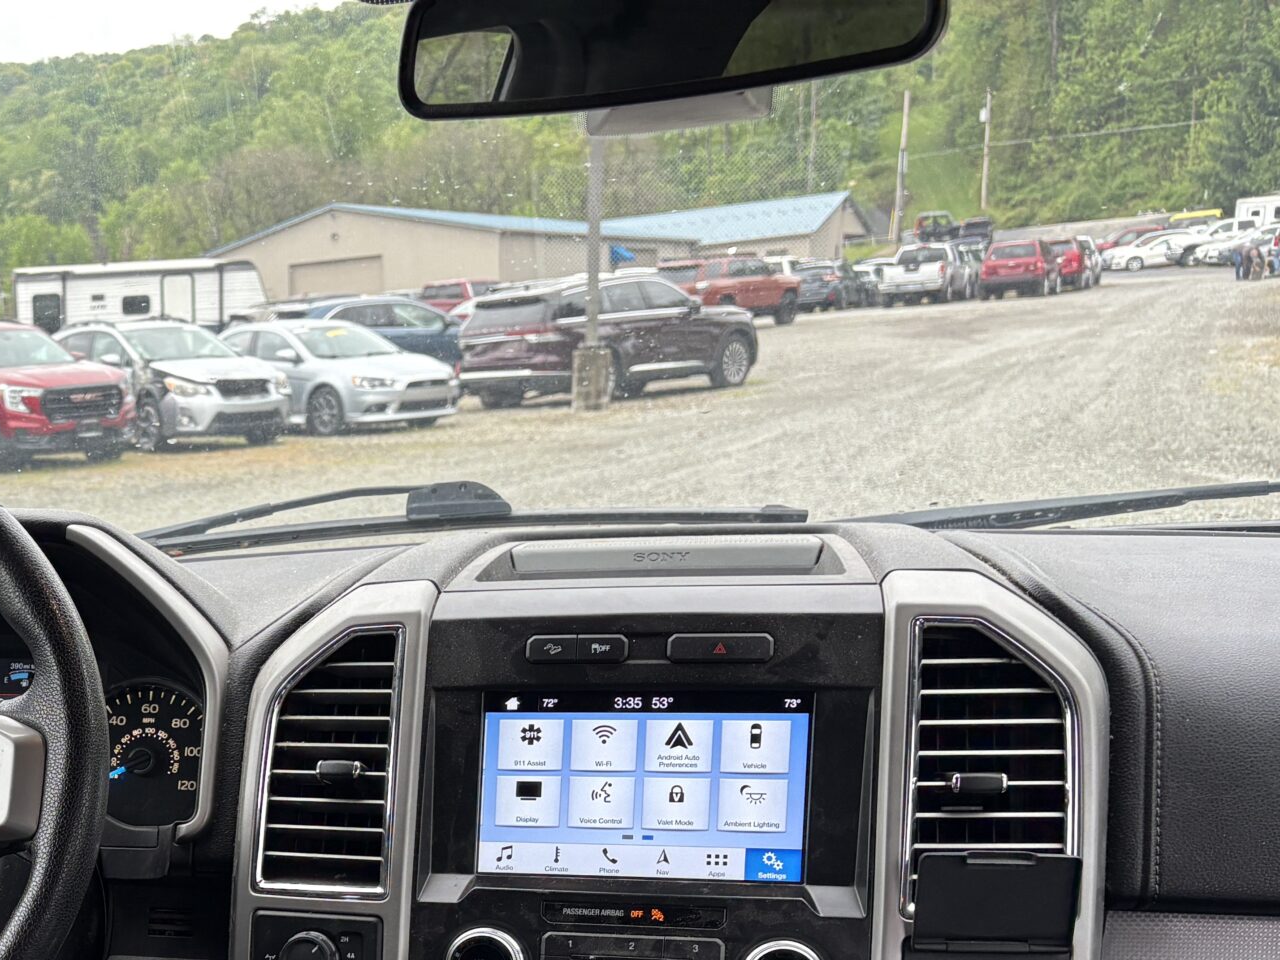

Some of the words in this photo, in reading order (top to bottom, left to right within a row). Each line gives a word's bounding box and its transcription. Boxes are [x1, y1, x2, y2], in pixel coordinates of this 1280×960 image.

[632, 551, 690, 563] SONY
[599, 643, 611, 652] OFF
[614, 697, 642, 709] 3:35
[141, 704, 159, 714] 60
[109, 716, 126, 725] 40
[171, 718, 190, 728] 80
[525, 731, 538, 739] 911
[178, 780, 197, 791] 120
[516, 816, 539, 824] Display
[674, 819, 694, 827] Mode
[723, 820, 752, 828] Ambient
[753, 821, 780, 829] Lighting
[544, 865, 569, 873] Climate
[708, 870, 726, 878] Apps
[757, 871, 787, 880] Settings
[562, 907, 600, 916] PASSENGER
[600, 908, 624, 917] AIRBAG
[630, 910, 644, 918] OFF
[568, 940, 573, 948] 1
[628, 942, 635, 950] 2
[692, 944, 699, 953] 3
